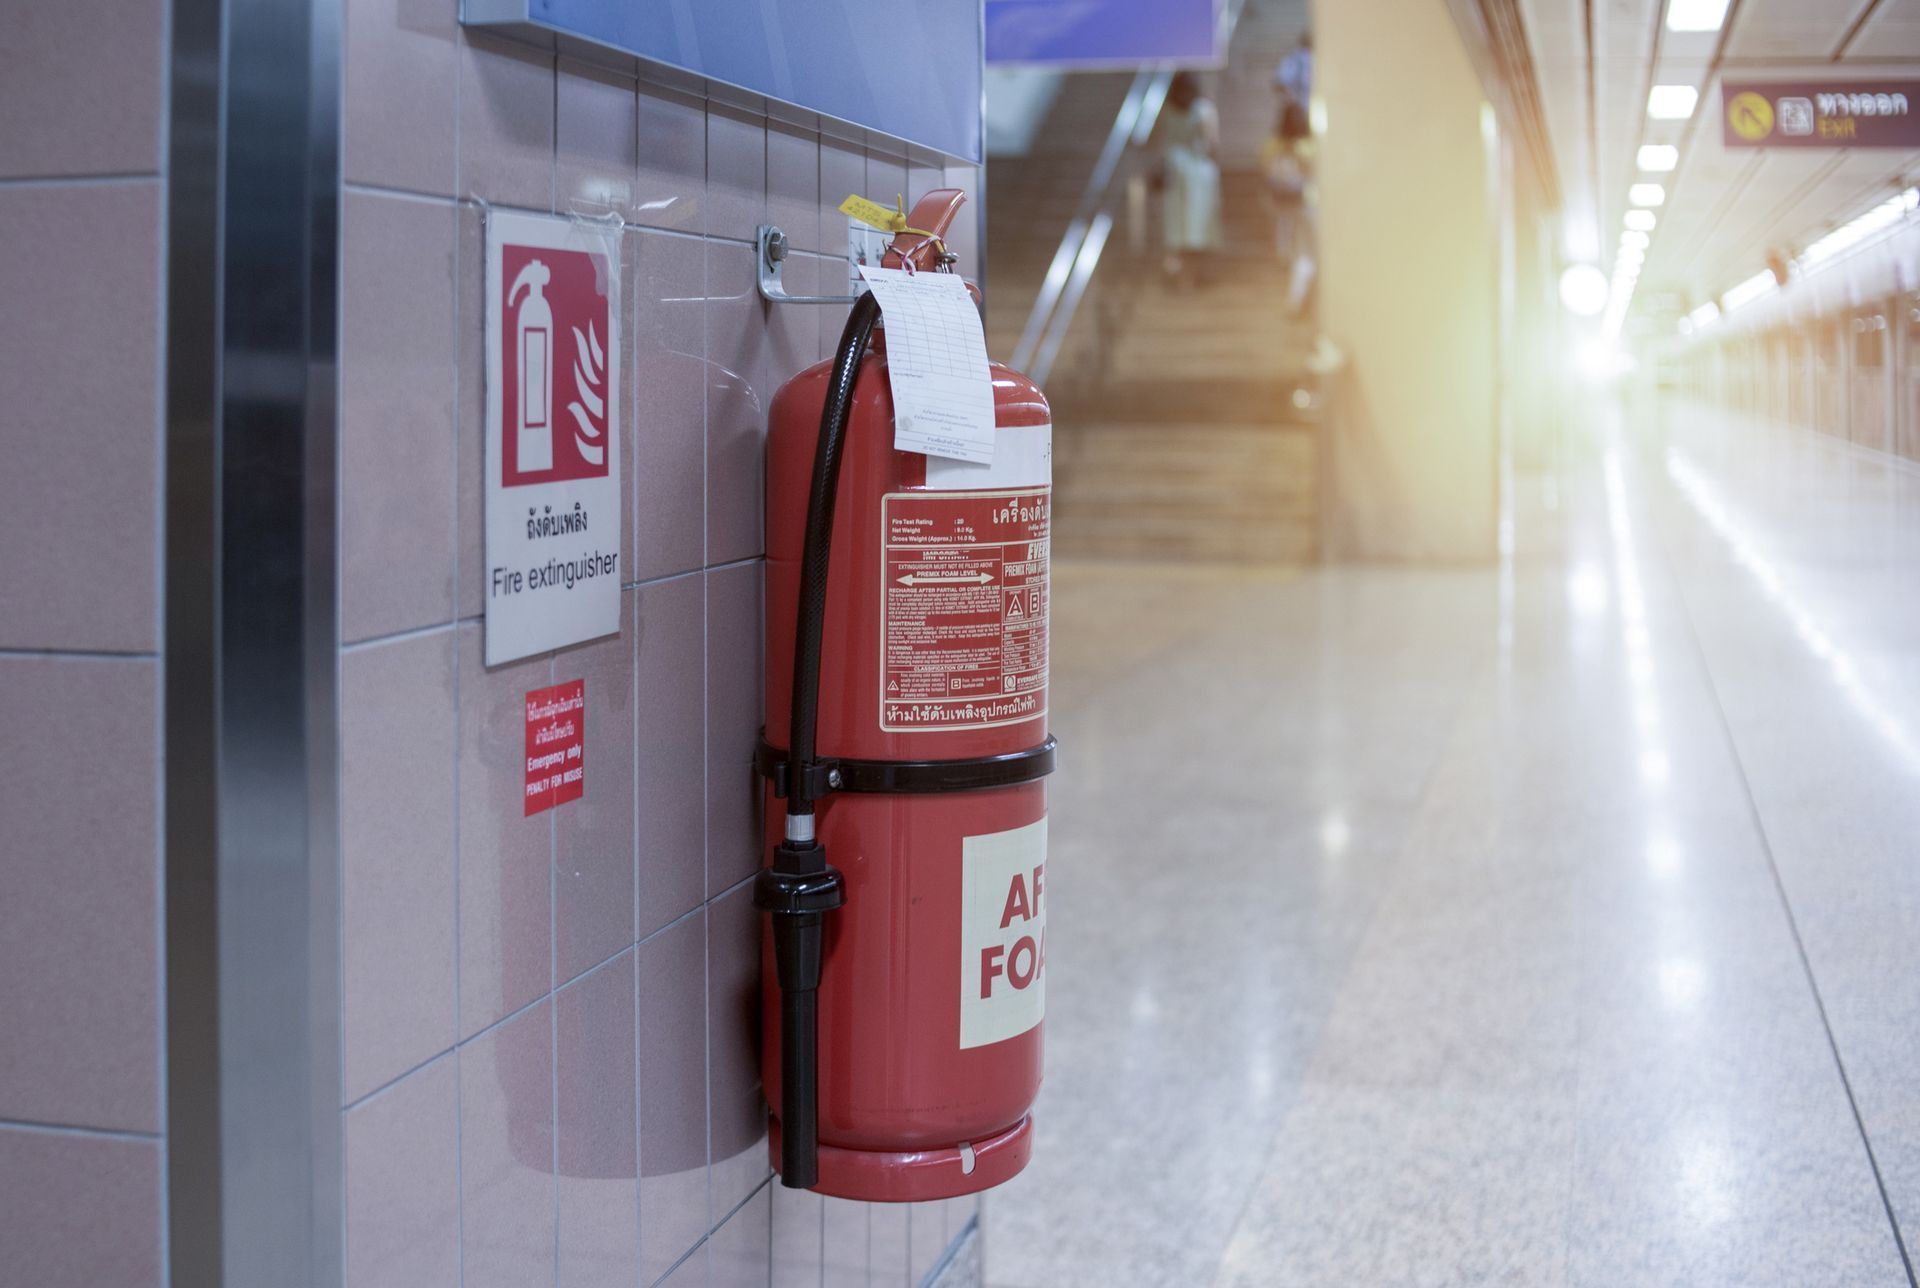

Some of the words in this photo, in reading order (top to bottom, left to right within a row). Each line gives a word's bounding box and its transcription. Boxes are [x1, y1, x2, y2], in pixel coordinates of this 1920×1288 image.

[1816, 92, 1908, 116] ทางออก
[1817, 117, 1857, 138] Exit
[527, 501, 587, 540] ถังดับเพลิง
[901, 527, 921, 535] Weight
[915, 518, 933, 526] Rating
[908, 535, 928, 543] Weight
[492, 566, 523, 597] Fire
[528, 549, 618, 590] extinguisher
[1004, 564, 1025, 577] PREMIX
[886, 695, 1036, 722] ห้ามใช้ดับเพลิงอุปกรณ์ไฟฟ้า
[527, 750, 565, 772] Emergency
[567, 743, 582, 759] only
[526, 778, 550, 797] PENALTY
[551, 773, 562, 789] FOR
[563, 766, 583, 784] MISUSE
